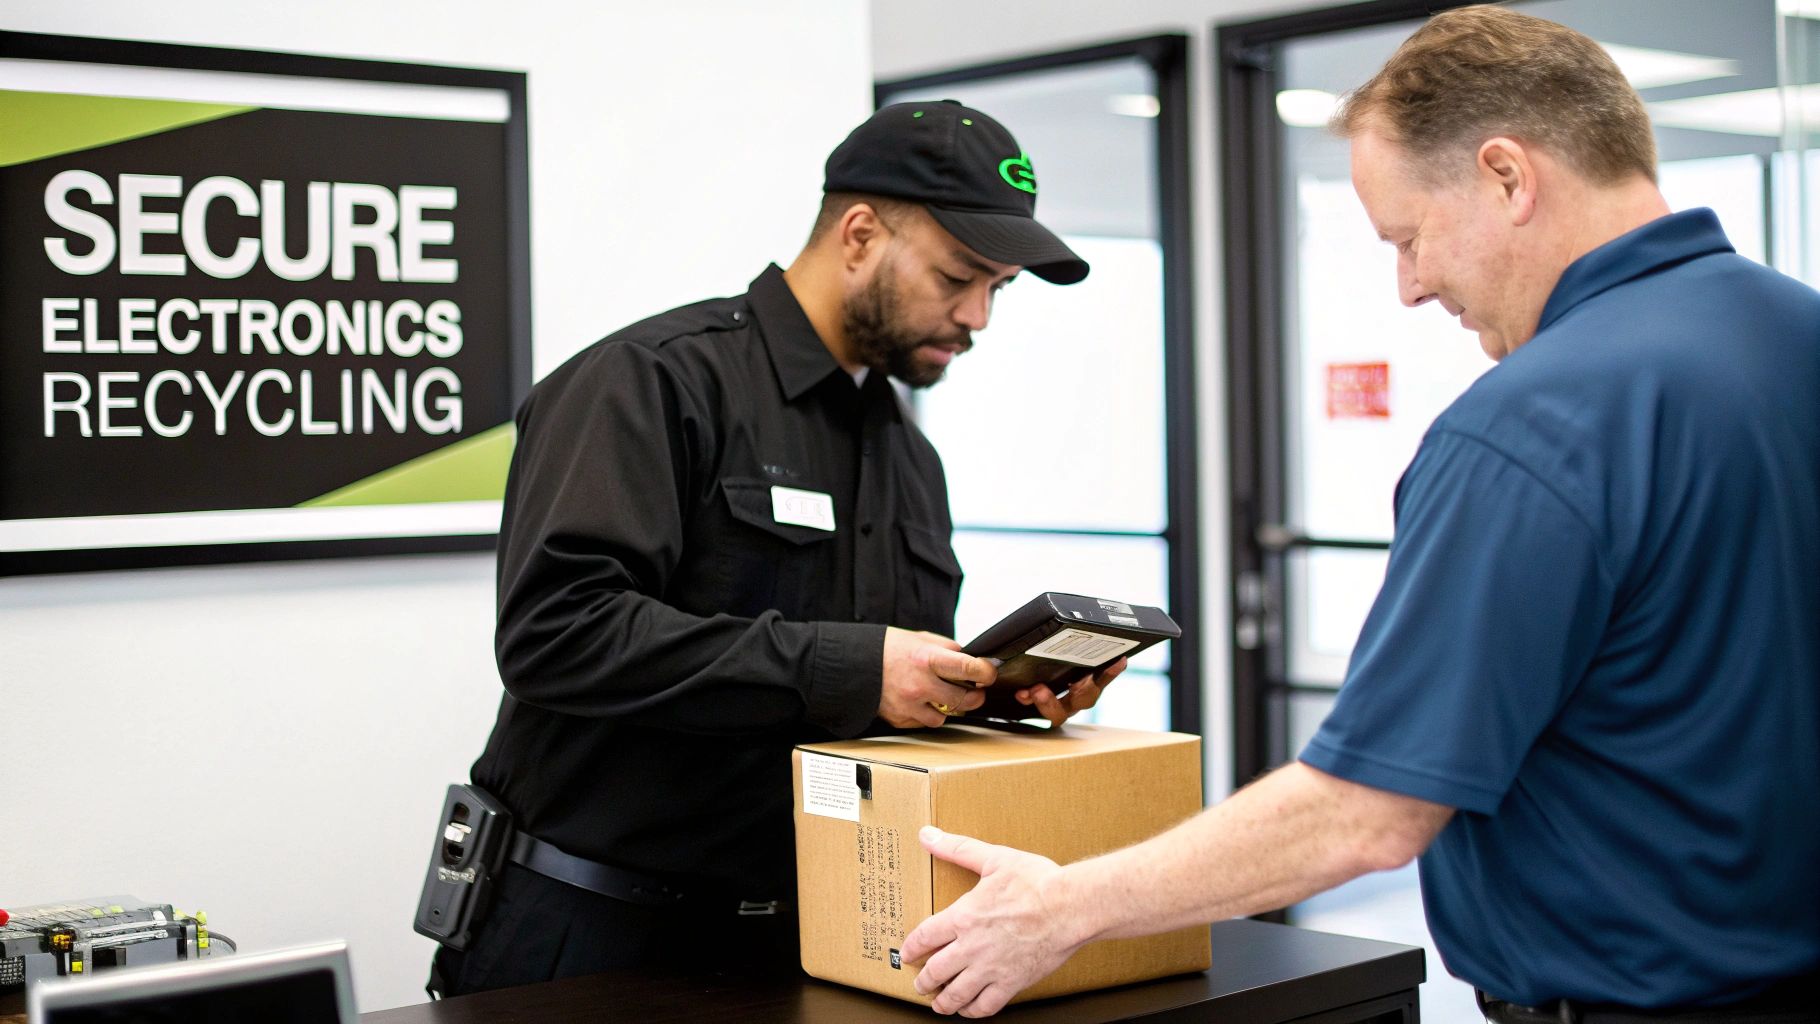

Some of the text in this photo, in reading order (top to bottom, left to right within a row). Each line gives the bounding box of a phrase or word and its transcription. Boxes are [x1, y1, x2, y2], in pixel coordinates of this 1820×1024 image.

[44, 170, 458, 283] SECURE
[43, 298, 463, 357] ELECTRONICS
[44, 367, 462, 437] RECYCLING
